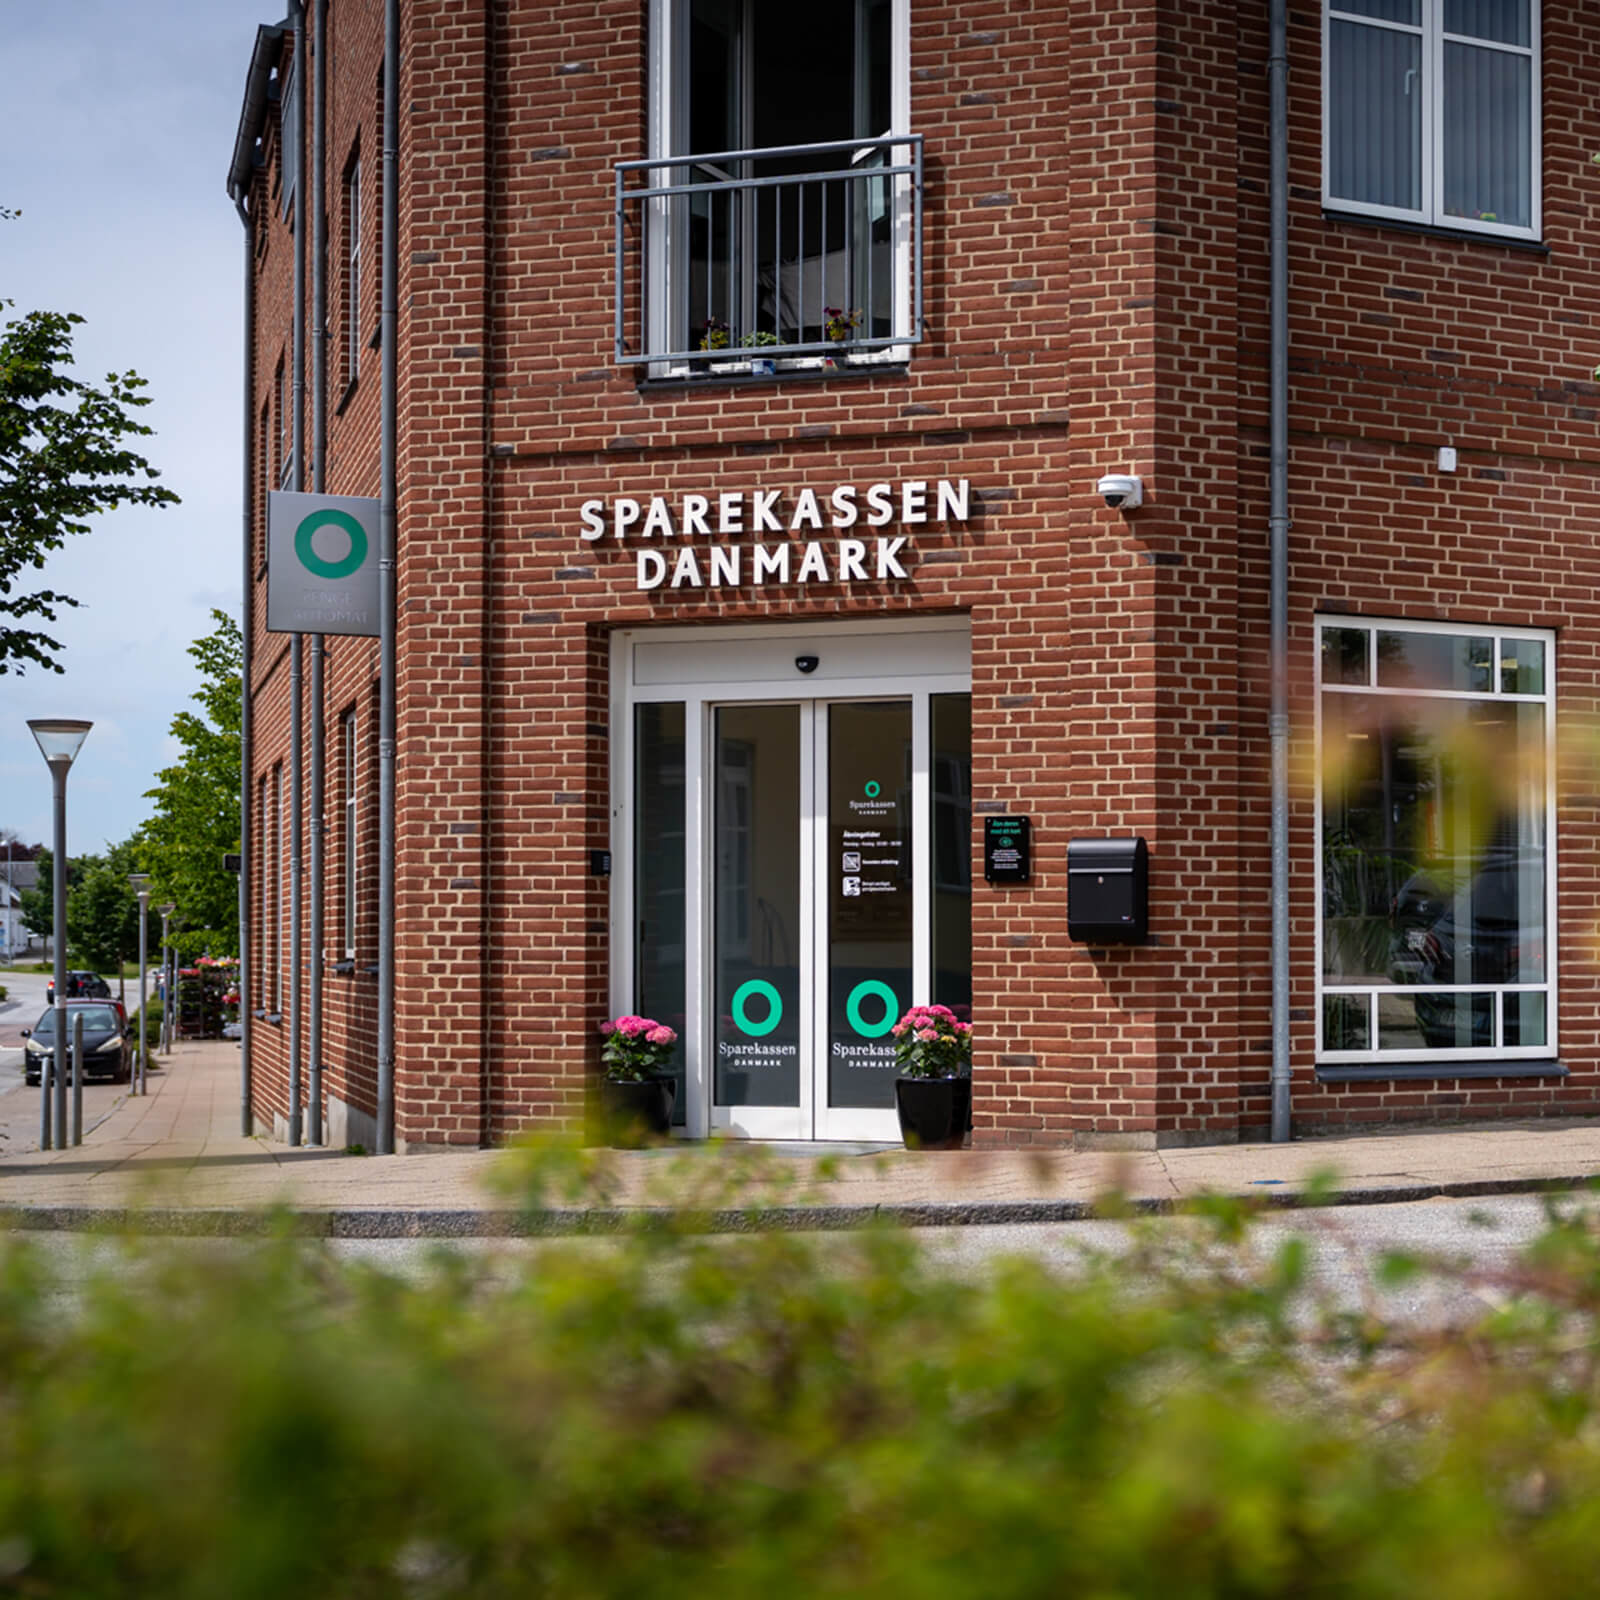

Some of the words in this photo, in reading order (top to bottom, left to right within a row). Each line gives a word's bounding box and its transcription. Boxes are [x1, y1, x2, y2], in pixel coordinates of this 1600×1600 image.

[580, 479, 970, 541] SPAREKASSEN
[636, 537, 911, 590] DANMARK
[719, 1042, 796, 1057] Sparekassen
[832, 1042, 897, 1058] Sparekass
